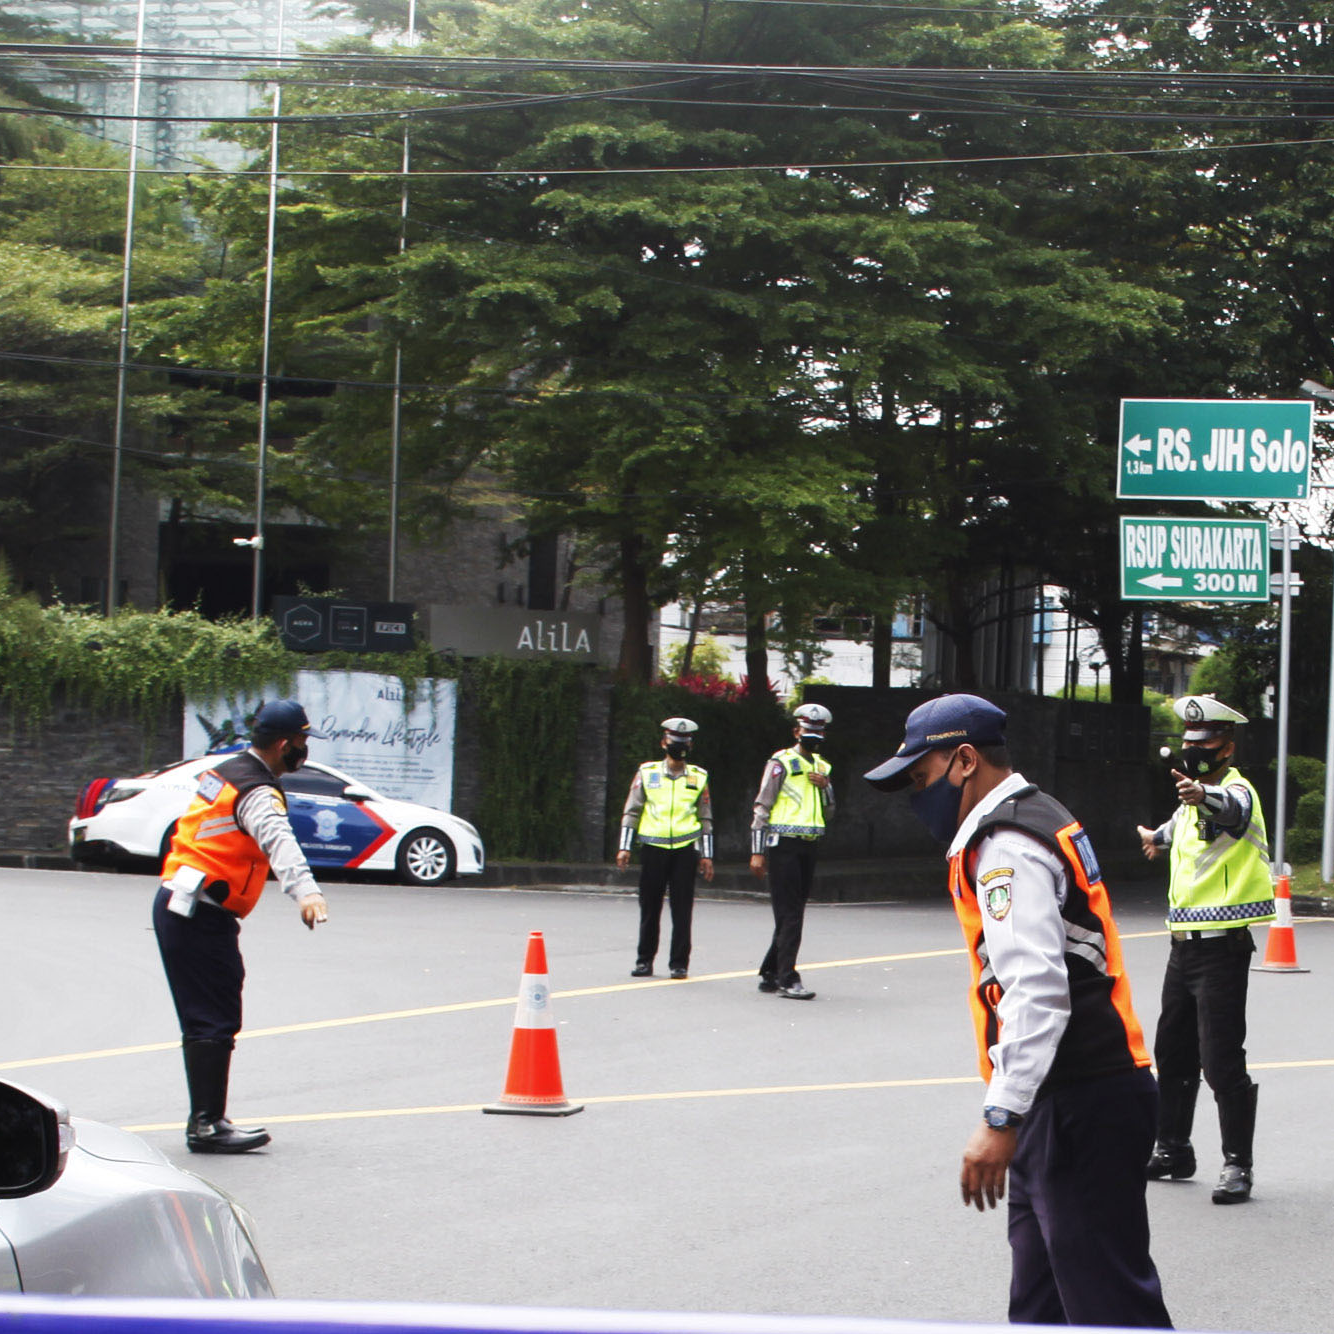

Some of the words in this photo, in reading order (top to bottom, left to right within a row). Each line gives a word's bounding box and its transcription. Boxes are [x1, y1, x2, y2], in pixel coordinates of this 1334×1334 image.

[1156, 427, 1198, 473] RS.
[1202, 427, 1246, 473] JIH
[1249, 428, 1307, 474] Solo
[1124, 524, 1168, 570] RSUP
[1169, 525, 1264, 571] SURAKARTA
[1192, 572, 1236, 592] 300
[1237, 573, 1259, 593] M
